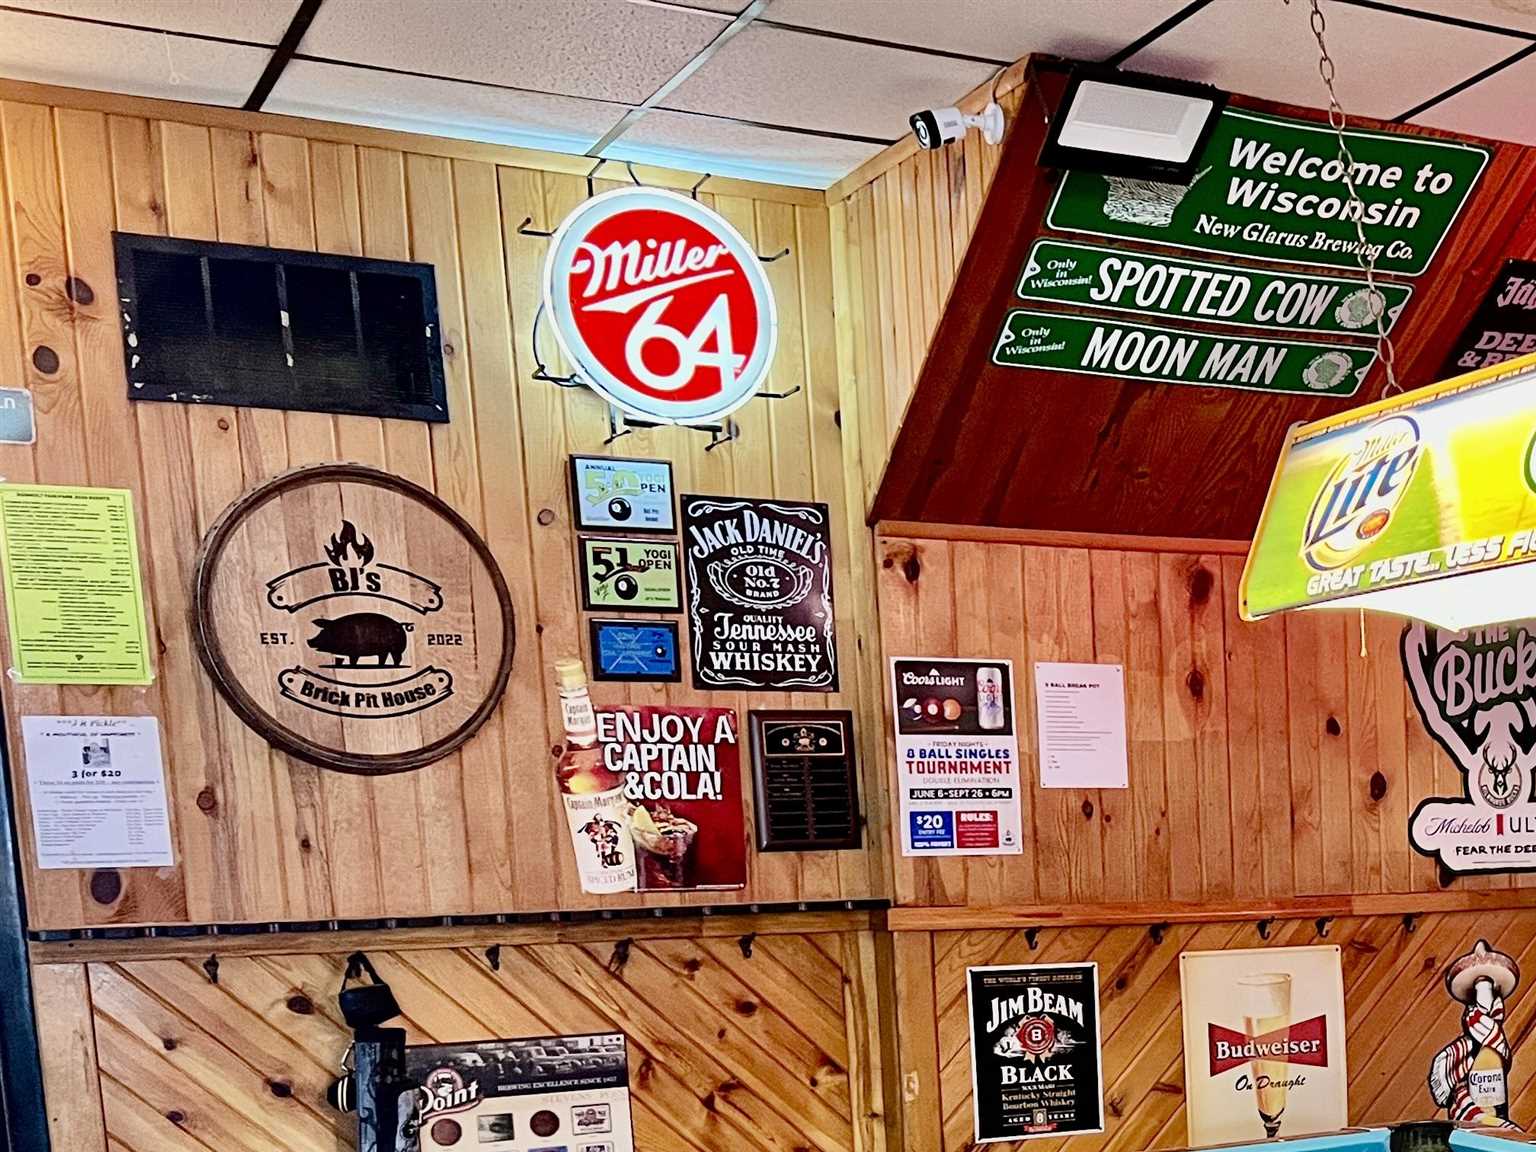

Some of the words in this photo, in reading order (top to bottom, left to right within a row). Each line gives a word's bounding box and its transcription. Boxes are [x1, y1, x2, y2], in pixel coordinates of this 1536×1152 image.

[1229, 137, 1403, 189] Welcome
[1414, 164, 1453, 195] to
[1227, 177, 1421, 228] Wisconsin
[1193, 214, 1241, 239] New
[1242, 223, 1306, 248] Glarus
[1309, 232, 1383, 260] Brewing
[1386, 240, 1413, 260] Co.
[568, 238, 728, 297] Miller
[1047, 259, 1077, 271] Only
[1056, 269, 1067, 278] in
[1030, 275, 1092, 289] Wisconsin!
[1089, 257, 1251, 317] SPOTTED
[1254, 280, 1339, 326] COW
[1021, 327, 1050, 338] Only
[1030, 337, 1041, 345] in
[625, 293, 746, 396] 64
[1005, 341, 1066, 355] Wisconsin!
[1081, 326, 1199, 376] MOON
[1199, 342, 1288, 385] MAN
[1309, 444, 1420, 547] Lite
[688, 518, 744, 559] JACK
[743, 509, 826, 565] DANIEL'S
[644, 549, 671, 560] YOGI
[731, 546, 754, 556] OLD
[758, 546, 785, 558] TIME
[592, 546, 628, 582] 51
[639, 559, 672, 570] OPEN
[746, 565, 776, 577] Old
[1307, 565, 1366, 596] GREAT
[1446, 534, 1505, 570] LESS
[746, 590, 780, 598] BRAND
[713, 612, 817, 643] Tennessee
[743, 614, 784, 624] QUALITY
[260, 632, 294, 645] EST.
[427, 633, 464, 646] 2022
[1474, 625, 1509, 646] THE
[712, 640, 761, 651] SOUR
[773, 643, 821, 654] MASH
[709, 651, 823, 673] WHISKEY
[299, 680, 351, 707] Brick
[355, 691, 379, 709] Pit
[382, 682, 437, 706] House
[596, 711, 704, 743] ENJOY
[714, 715, 736, 744] A
[604, 743, 715, 772] CAPTAIN
[906, 749, 915, 758] 8
[919, 748, 954, 759] BALL
[955, 748, 1010, 759] SINGLES
[81, 769, 97, 779] for
[906, 760, 1012, 775] TOURNAMENT
[912, 790, 935, 798] JUNE
[916, 814, 943, 829] $20
[1425, 816, 1490, 837] Michelob
[1456, 845, 1488, 855] FEAR
[1489, 845, 1511, 854] THE
[986, 995, 1026, 1033] JIM
[1027, 987, 1085, 1028] BEAM
[1216, 1038, 1322, 1062] Budweiser
[1000, 1064, 1075, 1085] BLACK
[1470, 1071, 1502, 1086] Corona
[1235, 1074, 1253, 1093] On
[1255, 1075, 1306, 1091] Draught
[418, 1080, 479, 1123] Point
[1001, 1091, 1040, 1102] Kentucky
[1043, 1089, 1076, 1098] Straight
[1002, 1100, 1039, 1110] Bourbon
[1041, 1099, 1075, 1107] Whiskey
